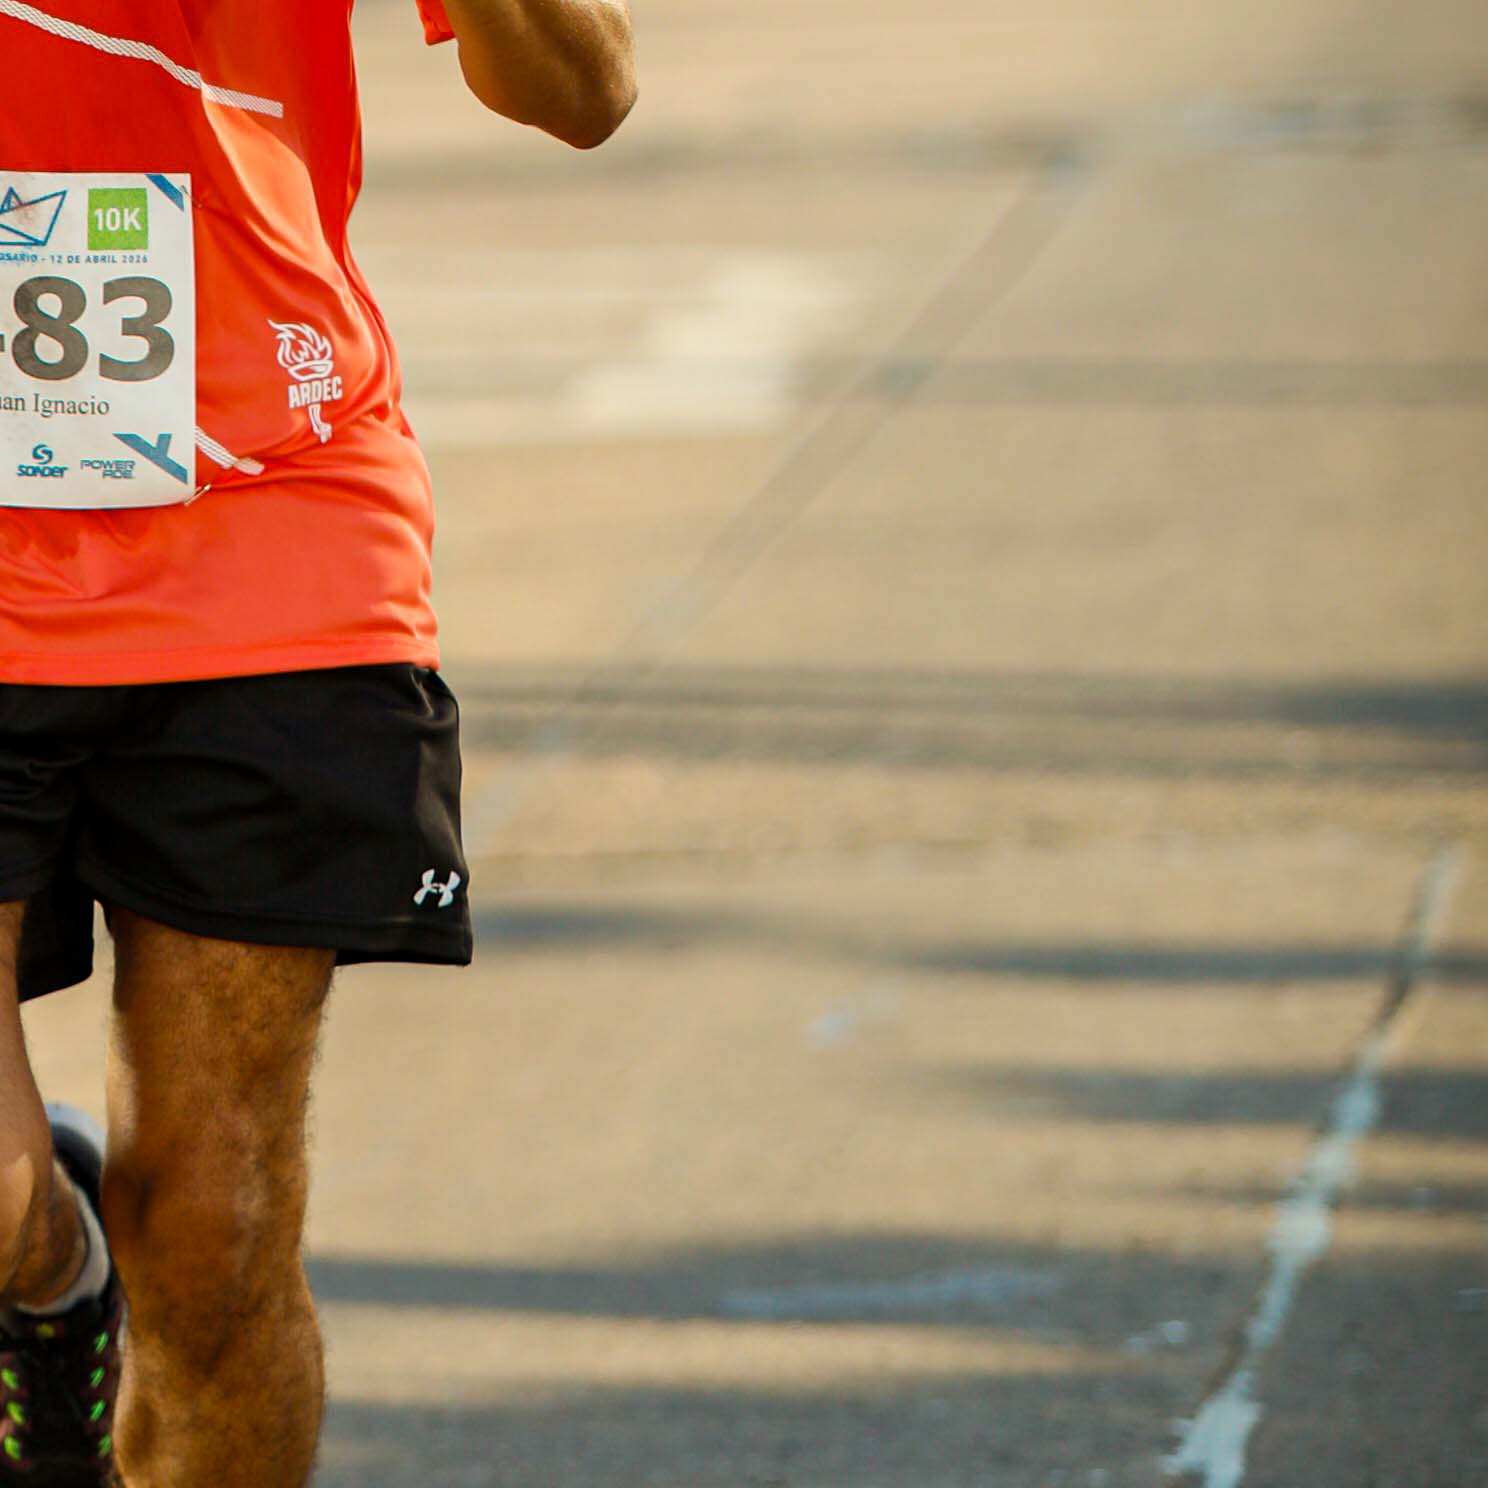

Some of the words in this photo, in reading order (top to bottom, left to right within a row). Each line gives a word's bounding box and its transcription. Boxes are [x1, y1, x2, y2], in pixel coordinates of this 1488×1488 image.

[93, 207, 142, 232] 10K
[50, 255, 62, 263] 12
[67, 255, 80, 263] DE
[85, 255, 117, 263] ABRIL
[122, 255, 148, 263] 2026
[288, 375, 343, 409] ARDEC
[33, 393, 110, 418] Ignacio
[80, 459, 136, 471] POWER
